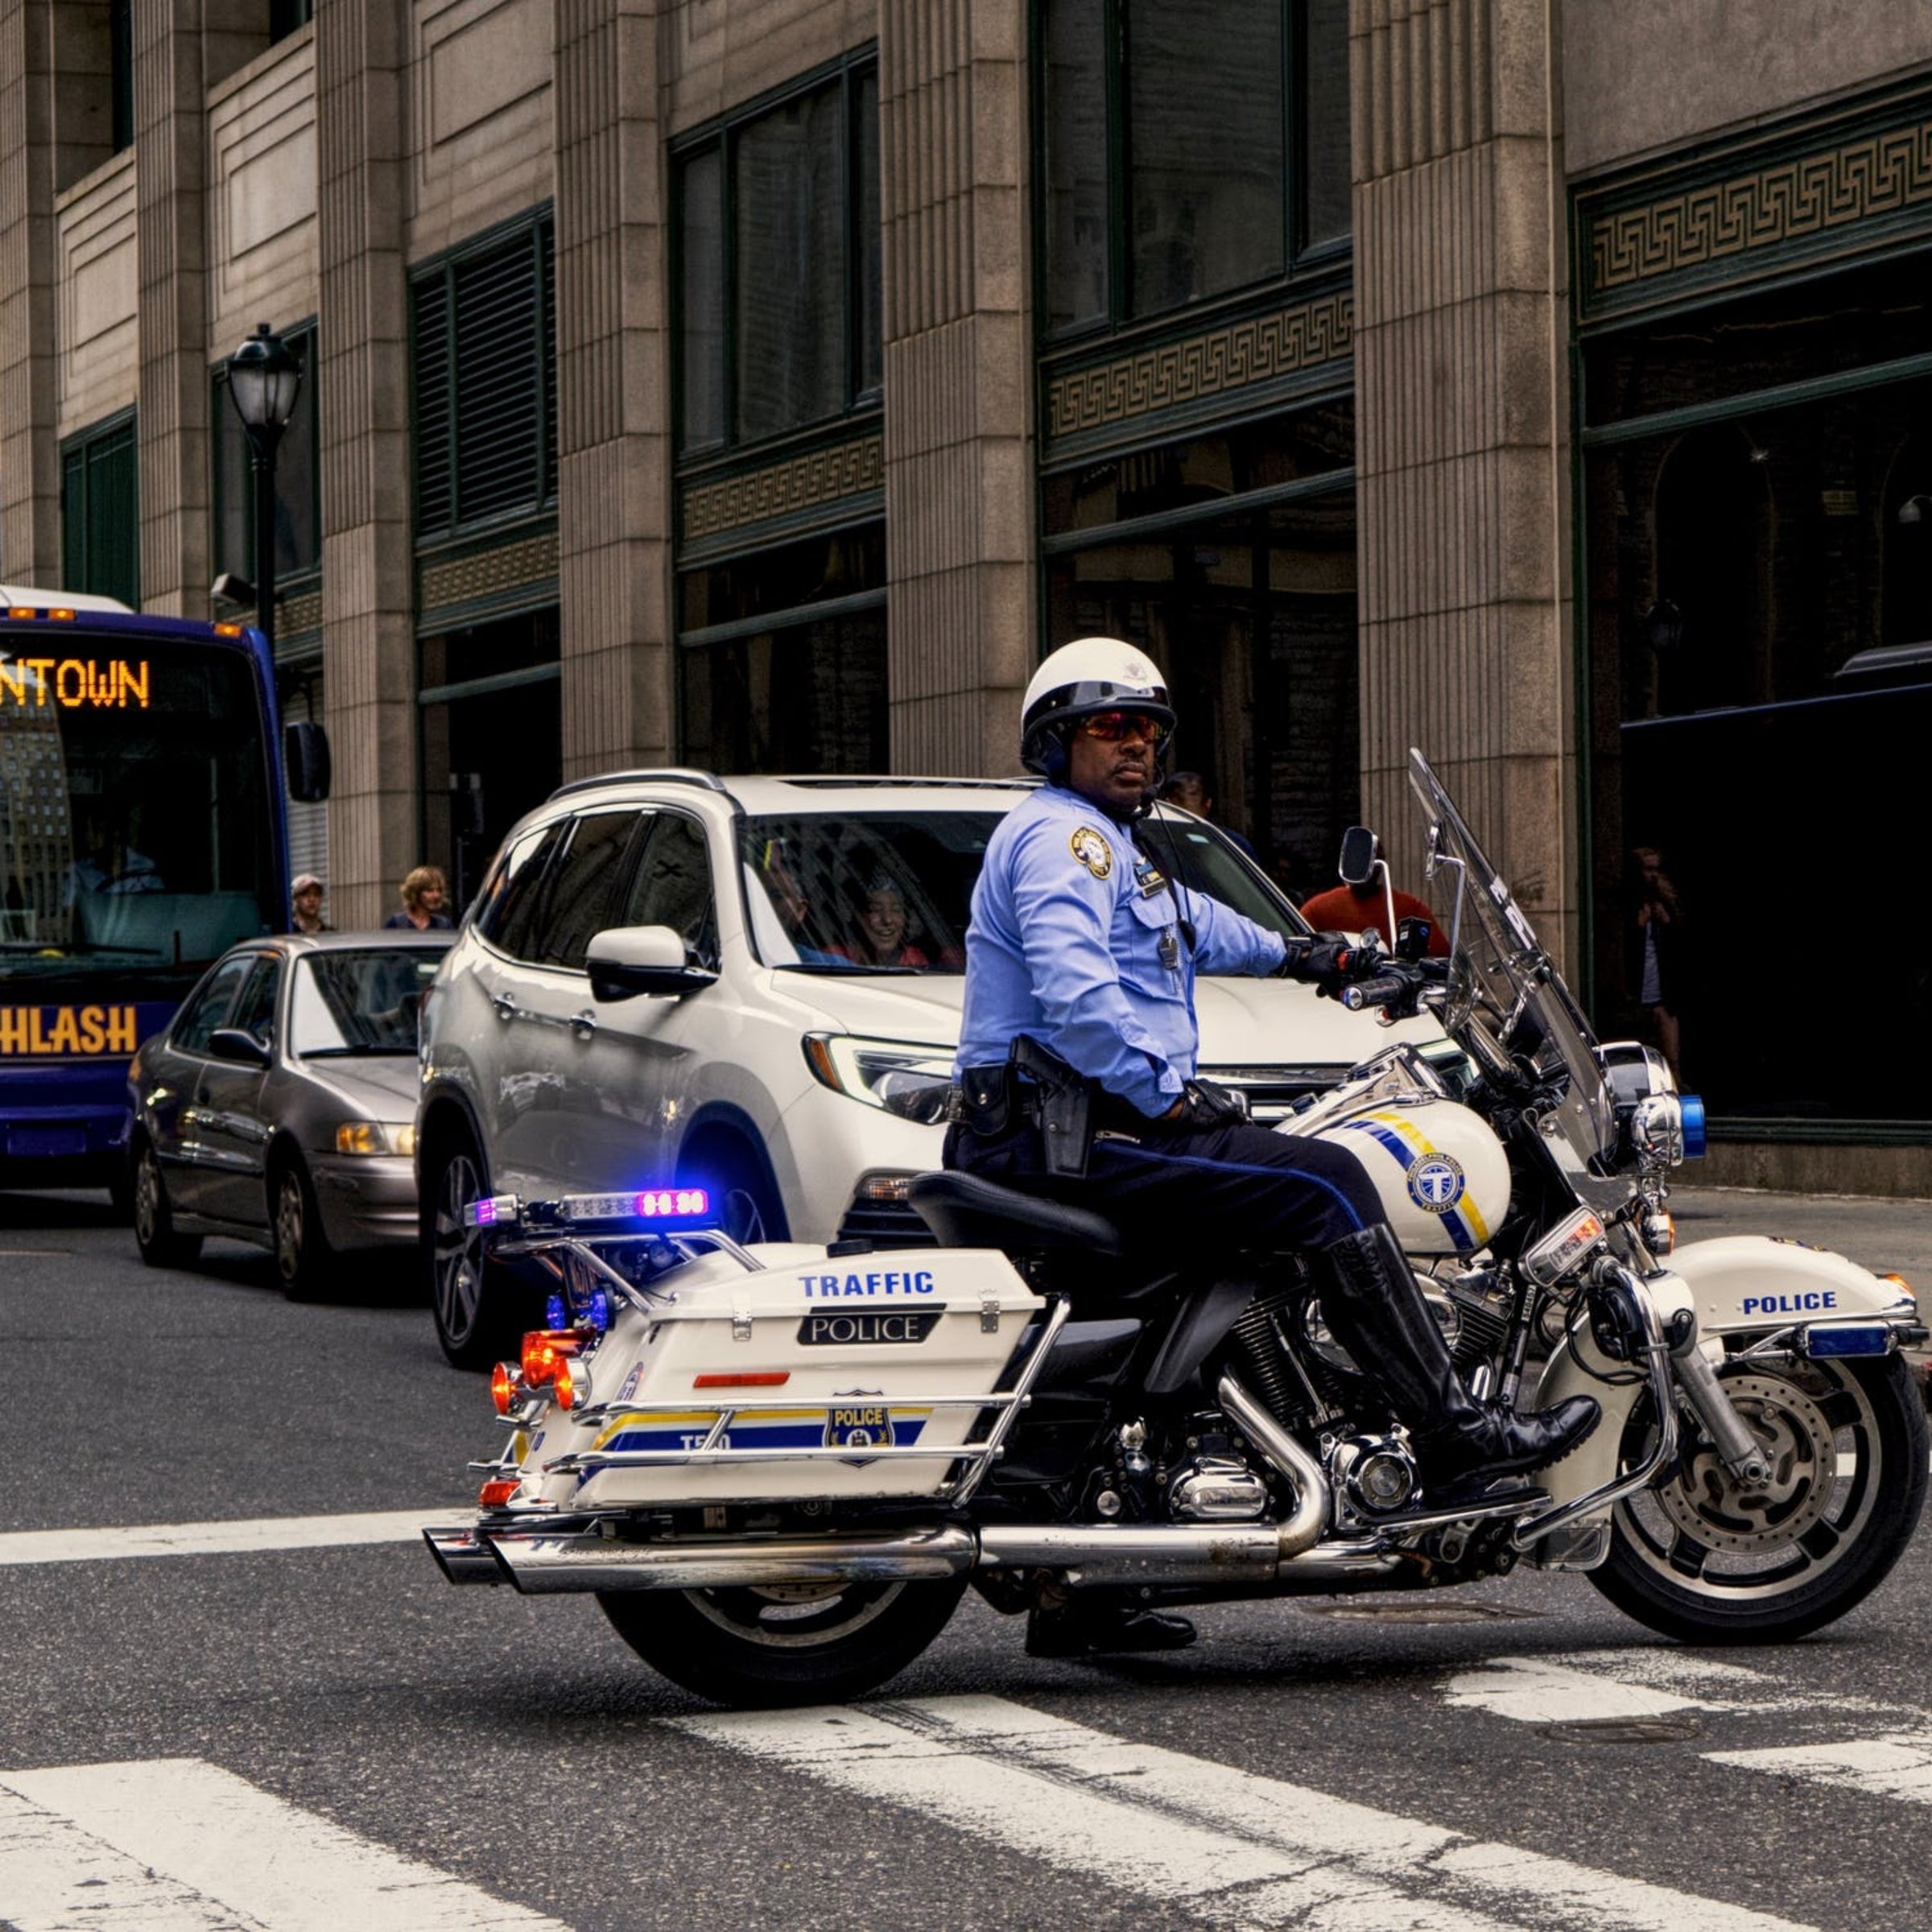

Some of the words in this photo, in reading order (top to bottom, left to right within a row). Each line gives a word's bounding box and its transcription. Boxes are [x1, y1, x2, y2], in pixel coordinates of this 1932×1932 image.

[0, 658, 149, 708] NTOWN
[0, 1005, 136, 1054] HLASH
[798, 1272, 934, 1297] TRAFFIC
[1743, 1291, 1837, 1315] POLICE
[811, 1317, 919, 1342] POLICE
[834, 1408, 884, 1427] POLICE
